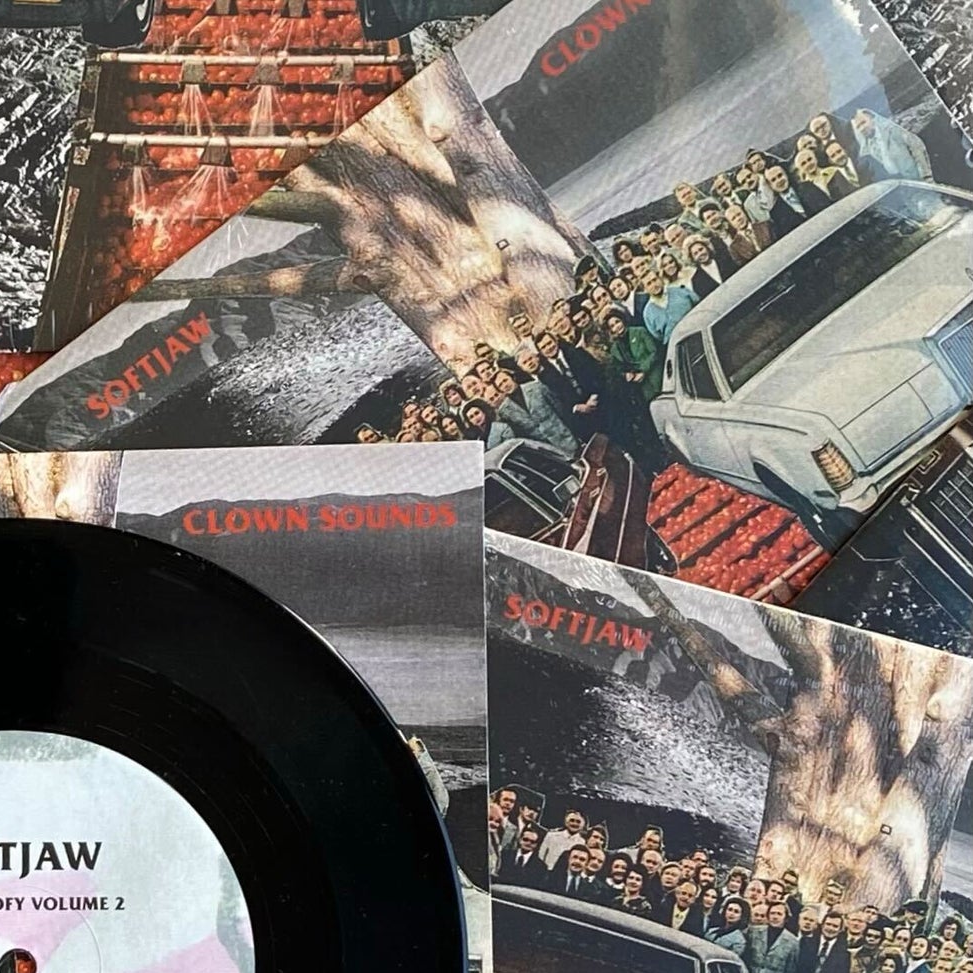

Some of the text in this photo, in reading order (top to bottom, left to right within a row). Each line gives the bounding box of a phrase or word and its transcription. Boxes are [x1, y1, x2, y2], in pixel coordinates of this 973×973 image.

[87, 311, 211, 419] SOFTJAW
[182, 502, 457, 535] CLOWN SOUNDS
[503, 592, 654, 653] SOFTJAW
[32, 896, 109, 911] VOLUME
[115, 896, 125, 911] 2
